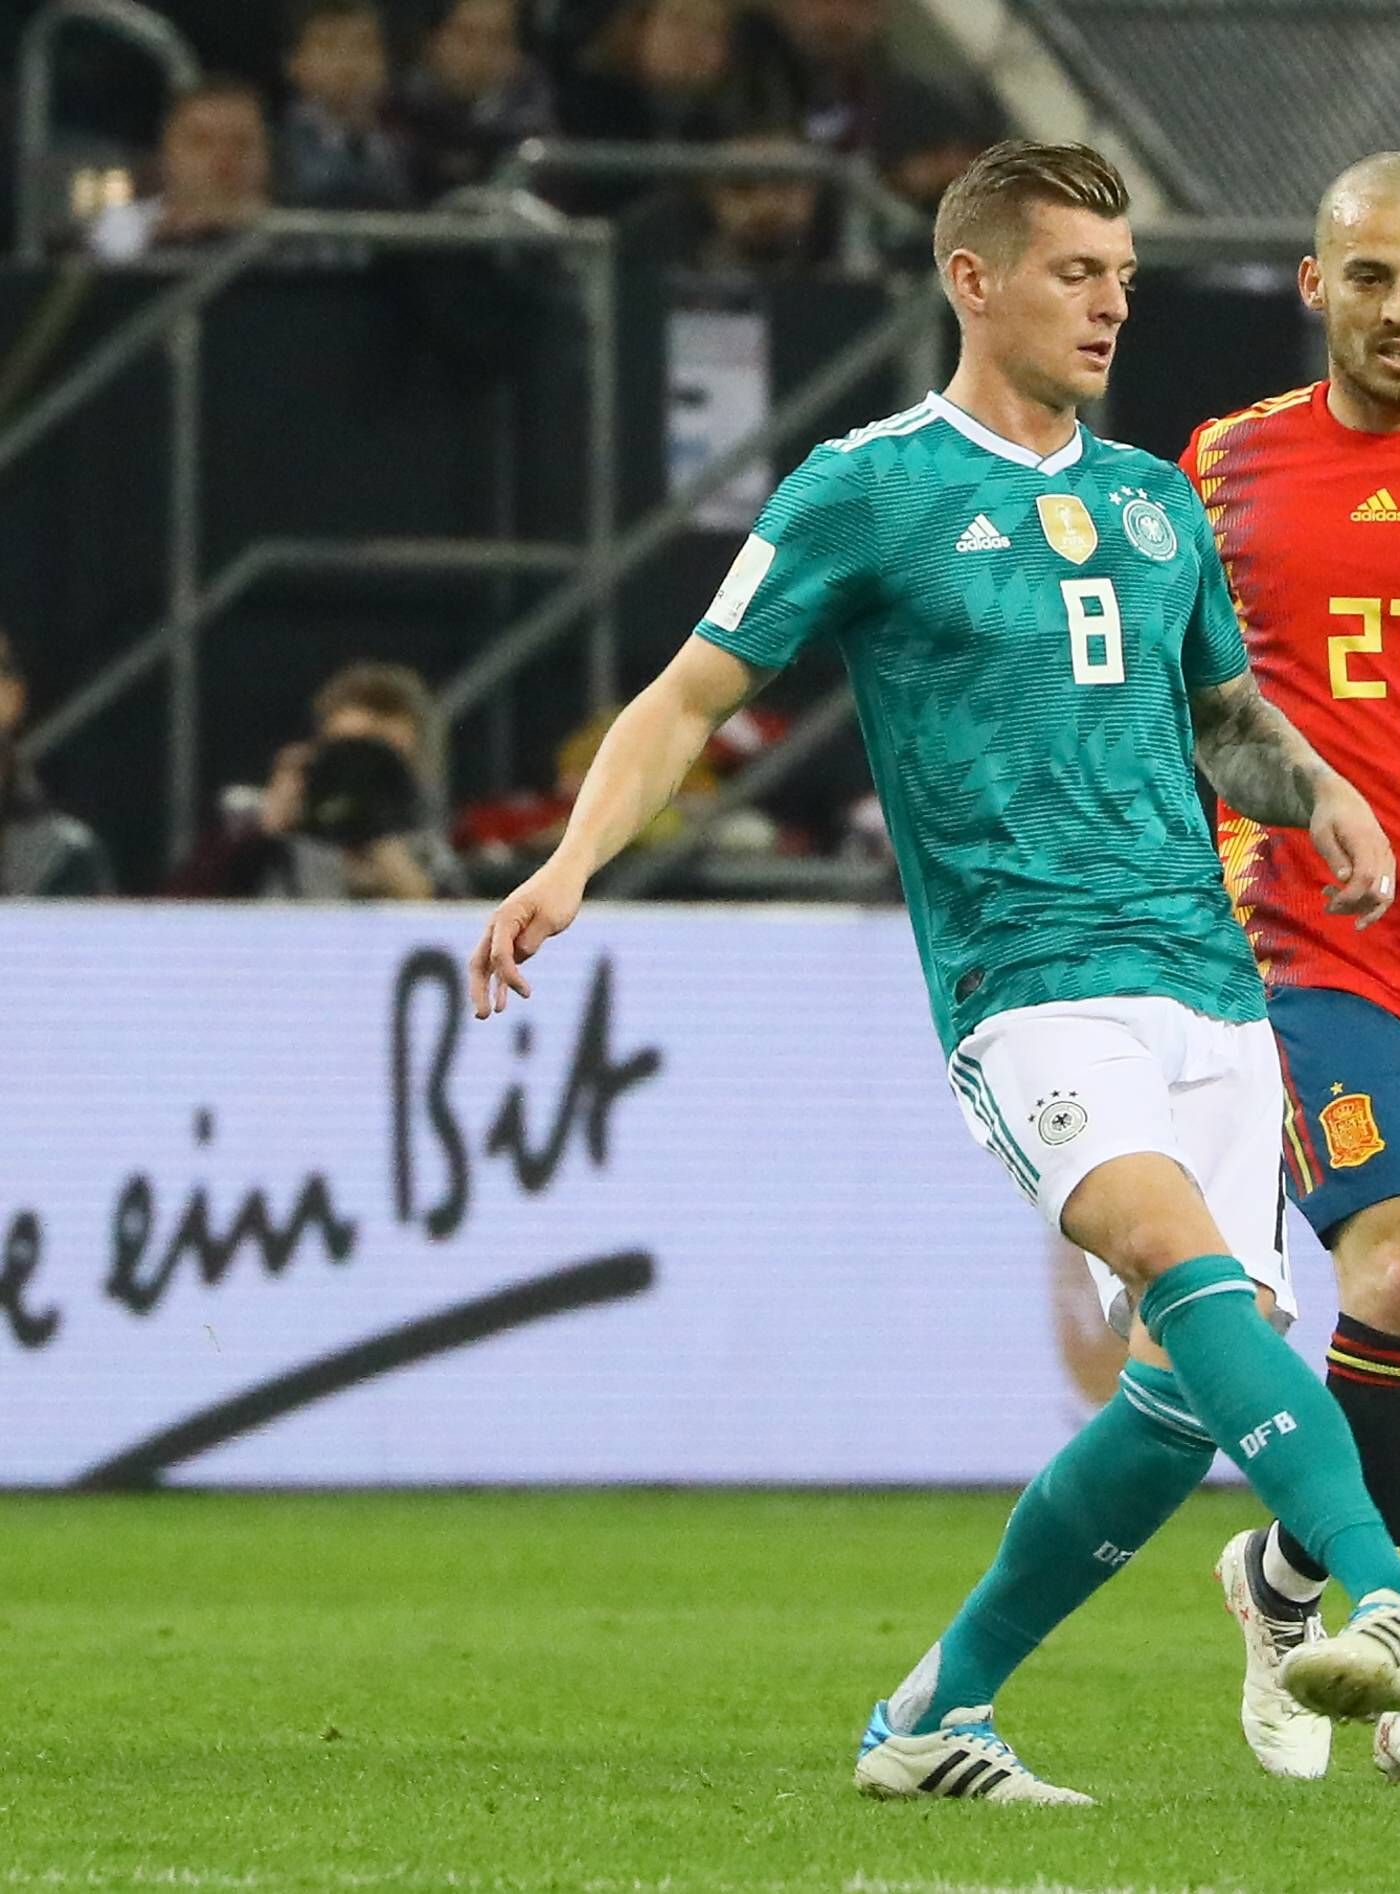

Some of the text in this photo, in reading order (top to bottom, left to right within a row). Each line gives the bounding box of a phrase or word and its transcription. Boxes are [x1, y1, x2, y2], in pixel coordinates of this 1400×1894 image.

[956, 536, 1011, 552] adidas
[1060, 578, 1125, 685] 8
[104, 1104, 360, 1316] ein
[390, 942, 665, 1242] Bit
[1239, 1410, 1298, 1460] DFB
